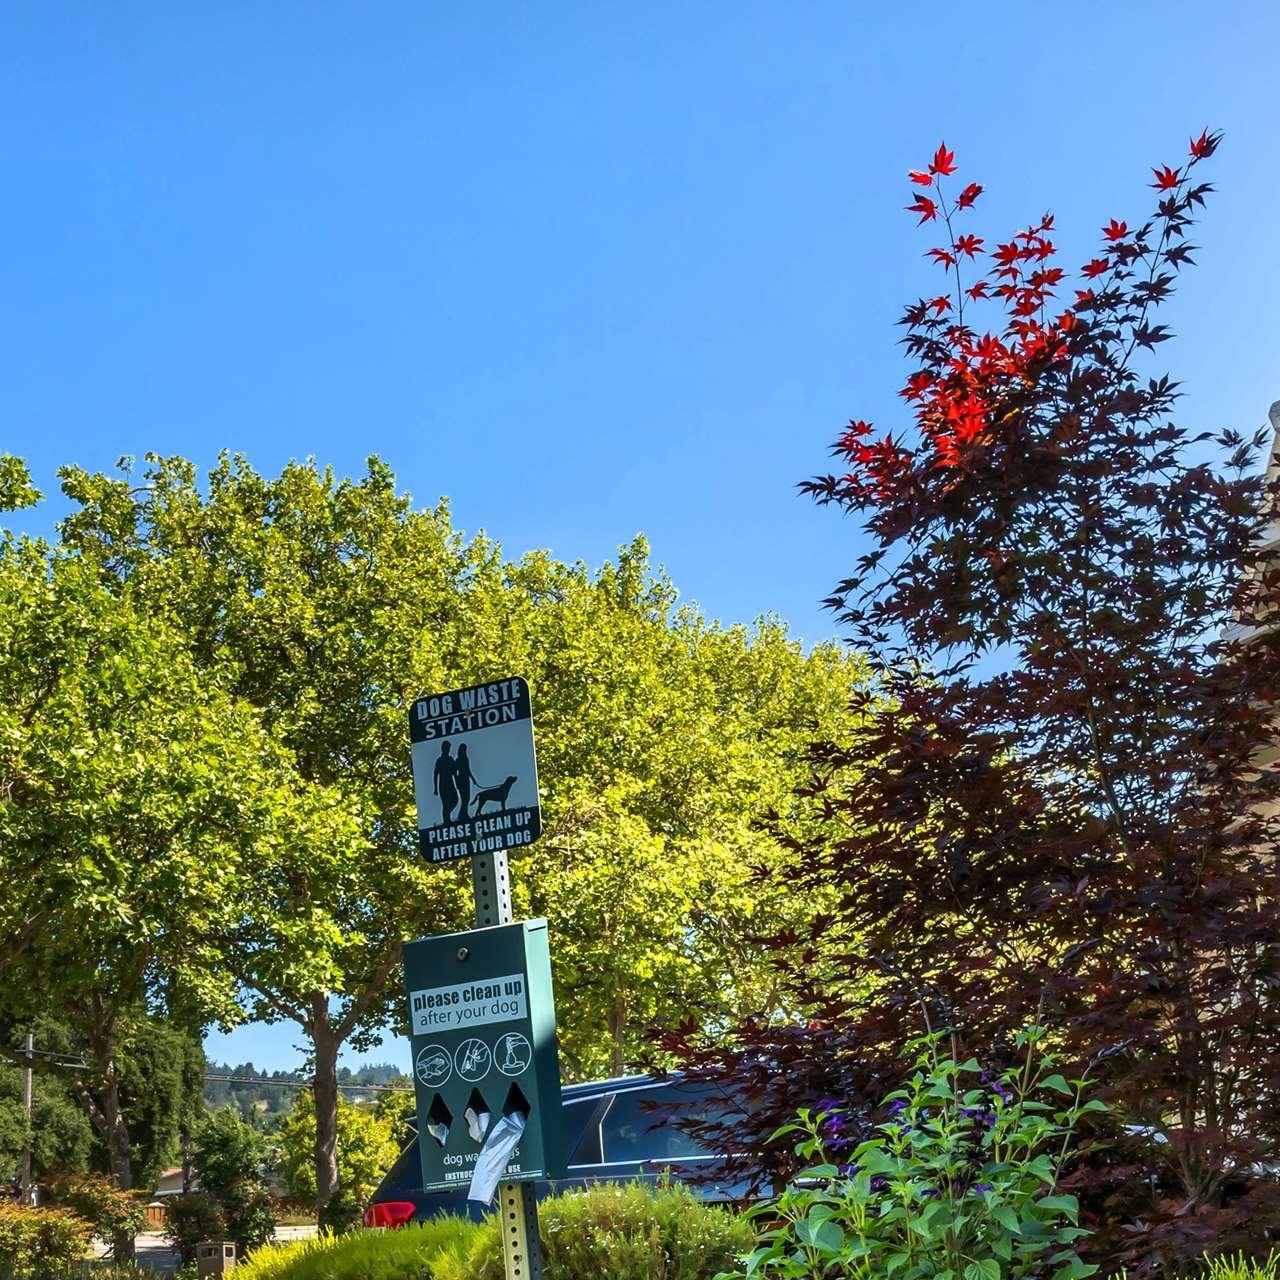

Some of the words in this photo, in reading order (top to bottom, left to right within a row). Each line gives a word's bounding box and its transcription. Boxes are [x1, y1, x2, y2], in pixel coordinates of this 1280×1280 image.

[417, 695, 453, 720] DOG
[459, 679, 520, 710] WASTE
[425, 704, 516, 738] STATION
[429, 824, 471, 843] PLEASE
[475, 815, 511, 834] CLEAN
[515, 811, 531, 827] UP
[432, 842, 468, 860] AFTER
[471, 835, 503, 853] YOUR
[507, 829, 531, 846] DOG
[414, 991, 460, 1012] please
[463, 984, 500, 1003] clean
[505, 980, 522, 996] up
[420, 1010, 452, 1026] after
[456, 1005, 488, 1024] your
[491, 1000, 519, 1016] dog
[443, 1153, 463, 1167] dog
[508, 1164, 521, 1174] USE
